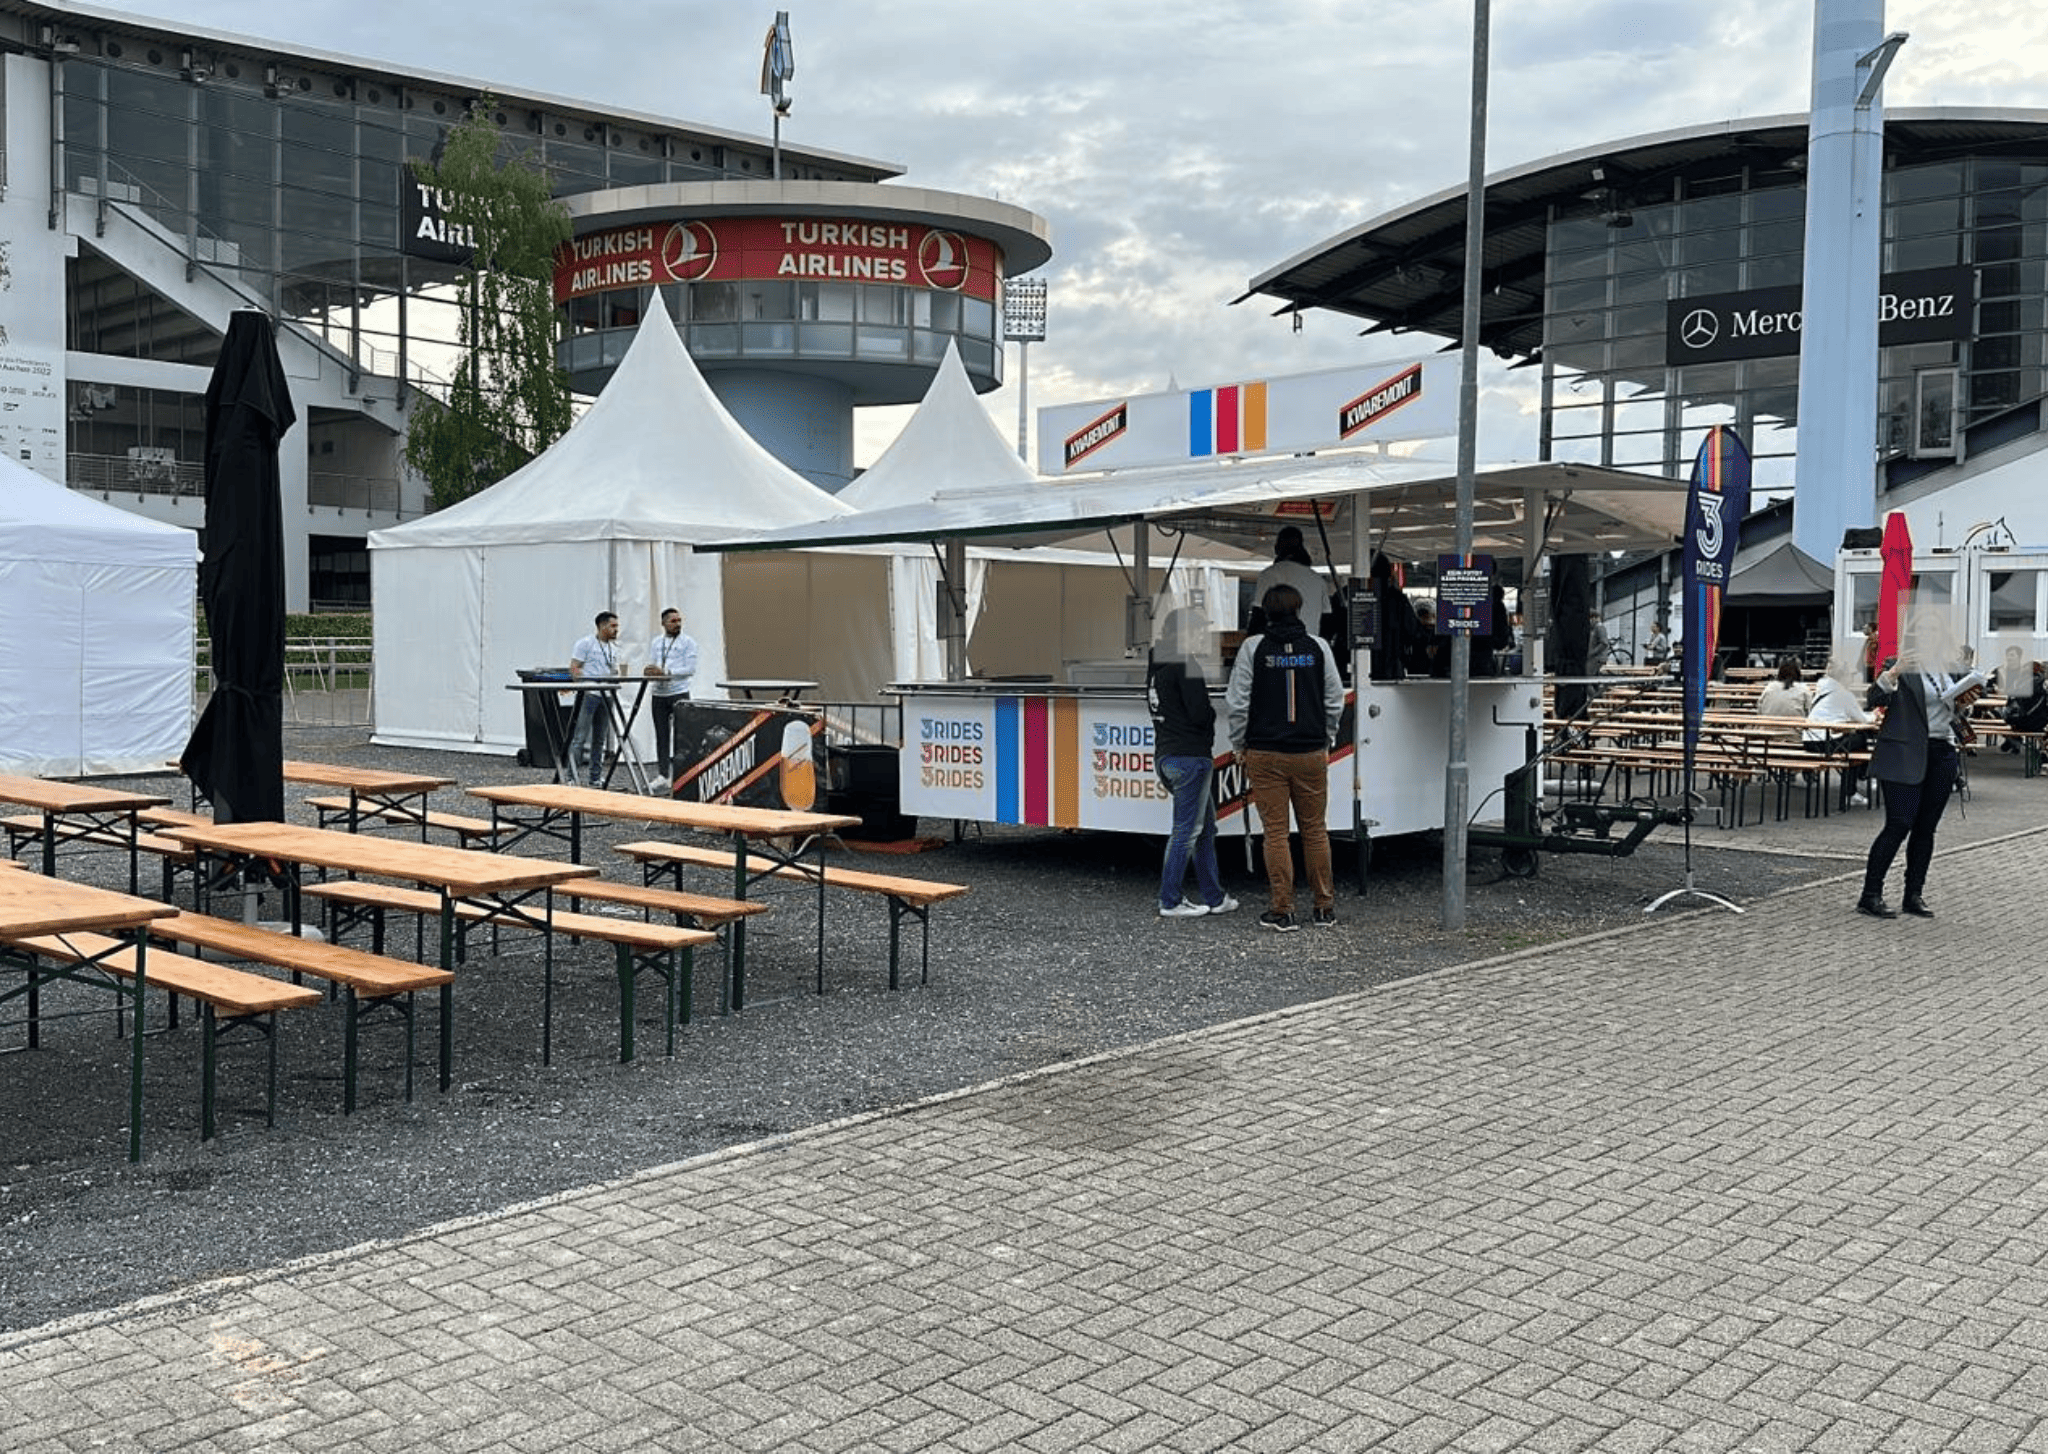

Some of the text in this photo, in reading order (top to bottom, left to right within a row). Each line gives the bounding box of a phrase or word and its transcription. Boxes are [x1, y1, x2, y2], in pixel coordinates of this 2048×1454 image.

[571, 229, 653, 263] TURKISH
[781, 222, 908, 250] TURKISH
[571, 260, 653, 292] AIRLINES
[778, 253, 907, 281] AIRLINES
[1347, 374, 1413, 429] KWAREMONT
[1696, 491, 1725, 559] 3
[1696, 560, 1724, 579] RIDES
[1264, 654, 1316, 668] 3RIDES
[921, 719, 983, 740] 3RIDES
[1093, 723, 1154, 746] 3RIDE
[920, 742, 983, 764] 3RIDES
[1092, 749, 1154, 772] 3RIDE
[920, 766, 984, 788] 3RIDES
[1093, 775, 1169, 799] 3RIDES
